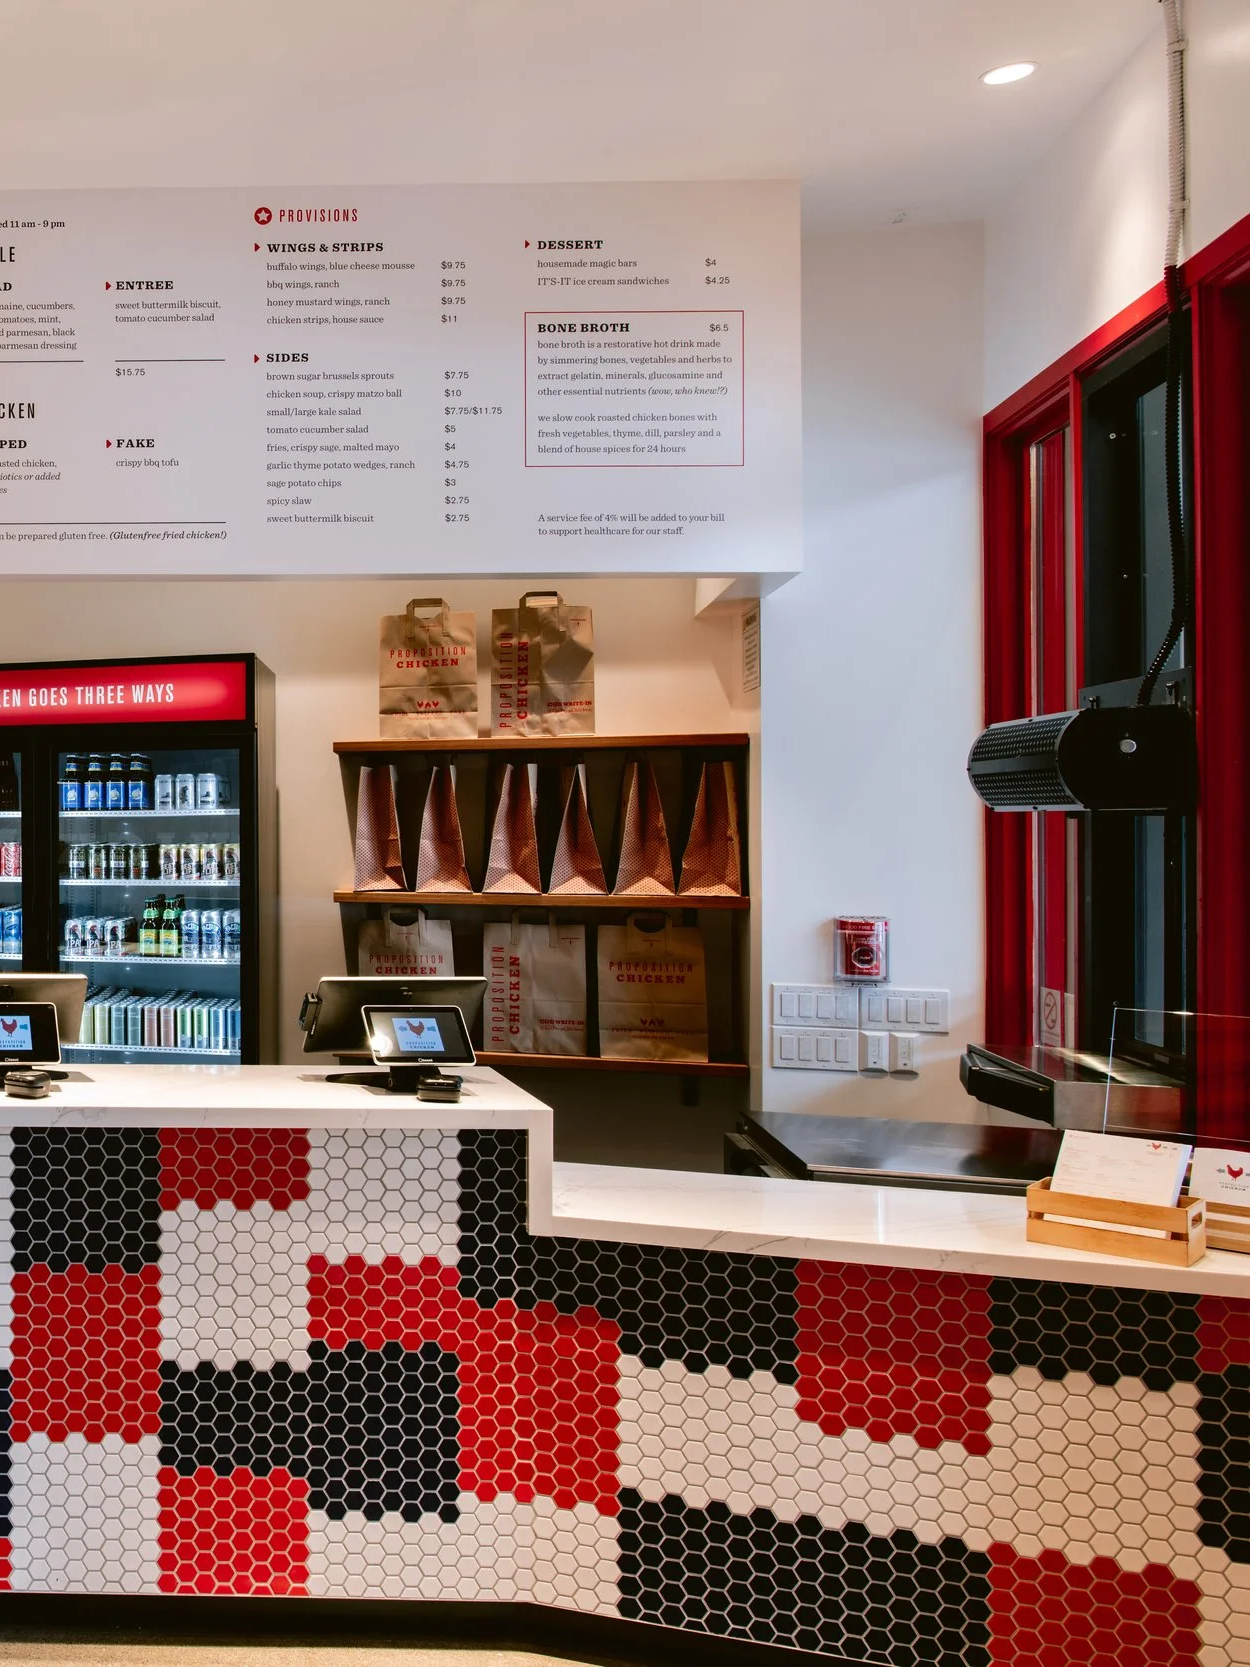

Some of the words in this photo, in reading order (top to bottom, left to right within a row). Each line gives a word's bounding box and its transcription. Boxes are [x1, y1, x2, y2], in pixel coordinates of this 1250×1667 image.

[280, 209, 357, 222] PROVISIONS
[267, 243, 315, 252] WINGS
[319, 244, 328, 252] &
[332, 243, 383, 252] STRIPS
[538, 240, 603, 249] DESSERT
[441, 261, 465, 270] $9.75
[705, 258, 716, 267] $4
[441, 279, 466, 287] $9.75
[538, 278, 571, 286] IT'S-IT
[617, 277, 669, 285] sandwiches
[705, 276, 730, 284] $4.25
[116, 281, 173, 290] ENTREE
[441, 296, 466, 305] $9.75
[441, 314, 456, 323] $11
[538, 324, 576, 332] BONE
[580, 323, 629, 332] BROTH
[710, 324, 728, 332] $6.5
[267, 353, 308, 362] SIDES
[116, 368, 145, 376] $15.75
[444, 371, 469, 380] $7.75
[444, 389, 461, 398] $10
[445, 406, 502, 415] $7.75/$11.75
[445, 424, 456, 433] $5
[117, 439, 154, 448] FAKE
[445, 442, 455, 451] $4
[116, 459, 142, 468] crispy
[144, 458, 159, 468] bbq
[162, 458, 179, 466] tofu
[445, 460, 469, 469] $4.75
[445, 478, 456, 486] $3
[267, 497, 290, 506] spicy
[292, 496, 312, 504] slaw
[445, 496, 469, 504] $2.75
[445, 514, 469, 522] $2.75
[390, 646, 466, 658] PROPOSITION
[397, 658, 459, 668] CHICKEN
[499, 632, 513, 728] PROPOSITION
[516, 641, 530, 720] CHICKEN
[29, 687, 69, 706] GOES
[75, 686, 124, 705] THREE
[132, 684, 174, 703] WAYS
[369, 953, 443, 964] PROPOSITION
[374, 966, 437, 975] CHICKEN
[610, 961, 695, 973] PROPOSITION
[617, 974, 686, 984] CHICKEN
[492, 946, 506, 1042] PROPOSITION
[509, 956, 520, 1035] CHICKEN
